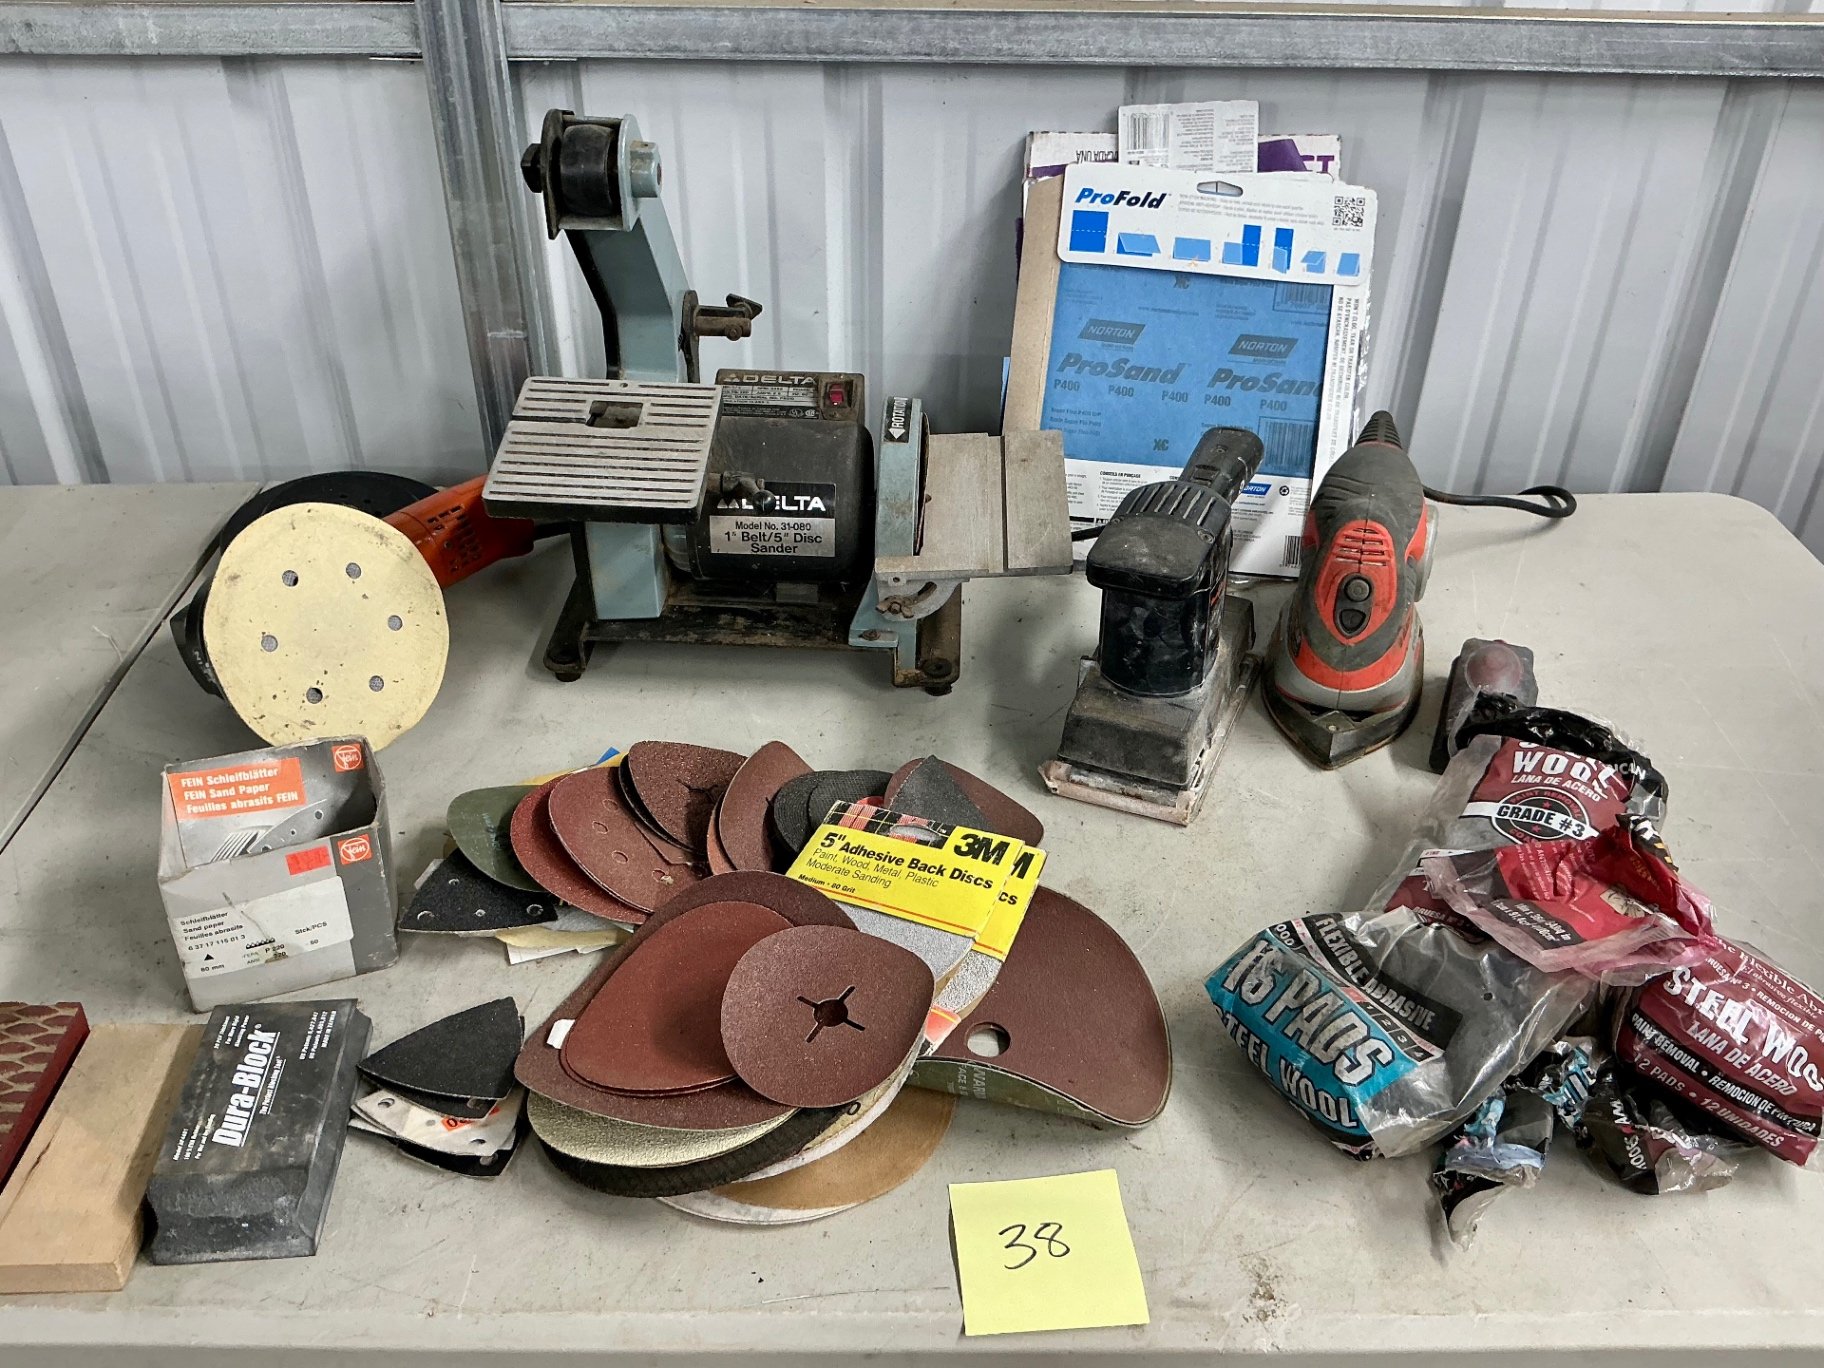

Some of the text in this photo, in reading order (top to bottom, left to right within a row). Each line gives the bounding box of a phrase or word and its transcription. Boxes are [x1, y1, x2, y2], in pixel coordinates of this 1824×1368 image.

[1075, 187, 1168, 210] ProFold
[1087, 325, 1137, 340] NORTON
[1237, 340, 1288, 354] NORTON
[742, 374, 817, 385] DELTA
[1057, 352, 1187, 385] ProSand
[1054, 379, 1189, 403] P400 P400 P400
[1204, 394, 1288, 412] P400 P400
[890, 397, 908, 428] ROTATION
[1243, 485, 1267, 493] ORTON
[735, 521, 812, 532] Model No. 31-080
[793, 533, 823, 544] Disc
[751, 543, 799, 555] Sander
[181, 766, 280, 788] FEIN Schleifblätter
[184, 783, 270, 801] FEIN Sand Paper
[1511, 774, 1601, 802] LANA DE ACERO
[187, 791, 299, 814] Feuilles abrasifs FEIN
[1496, 805, 1557, 825] GRADE
[1558, 817, 1586, 838] #3
[820, 831, 993, 889] 5" Adhesive Back Discs
[953, 832, 1010, 866] 3M
[805, 857, 892, 889] Moderate Sanding
[812, 847, 838, 864] Paint,
[841, 856, 870, 872] Wood,
[906, 871, 940, 888] Plastic
[798, 873, 826, 887] Medium
[842, 885, 856, 894] Grit
[182, 920, 225, 935] Sand paper
[1314, 916, 1437, 1032] FLEXIBLE ABRASIVE
[1739, 951, 1796, 995] Flexible
[1797, 993, 1824, 1017] Abr
[1221, 939, 1397, 1088] 16 PADS
[1742, 982, 1751, 990] 3
[1756, 990, 1802, 1024] REMOCION
[1801, 1019, 1814, 1032] DE
[1663, 966, 1824, 1092] STEEL WOO
[1654, 1032, 1702, 1075] REMOVAL
[1708, 1074, 1763, 1110] REMOCION
[1759, 1098, 1773, 1113] DE
[1686, 1020, 1798, 1097] LANA DE ACERO
[1279, 1055, 1360, 1130] WOOL
[1650, 1064, 1686, 1093] PADS
[1699, 1097, 1719, 1112] 12
[1716, 1107, 1785, 1148] UNIDADES
[998, 1221, 1071, 1270] 38
